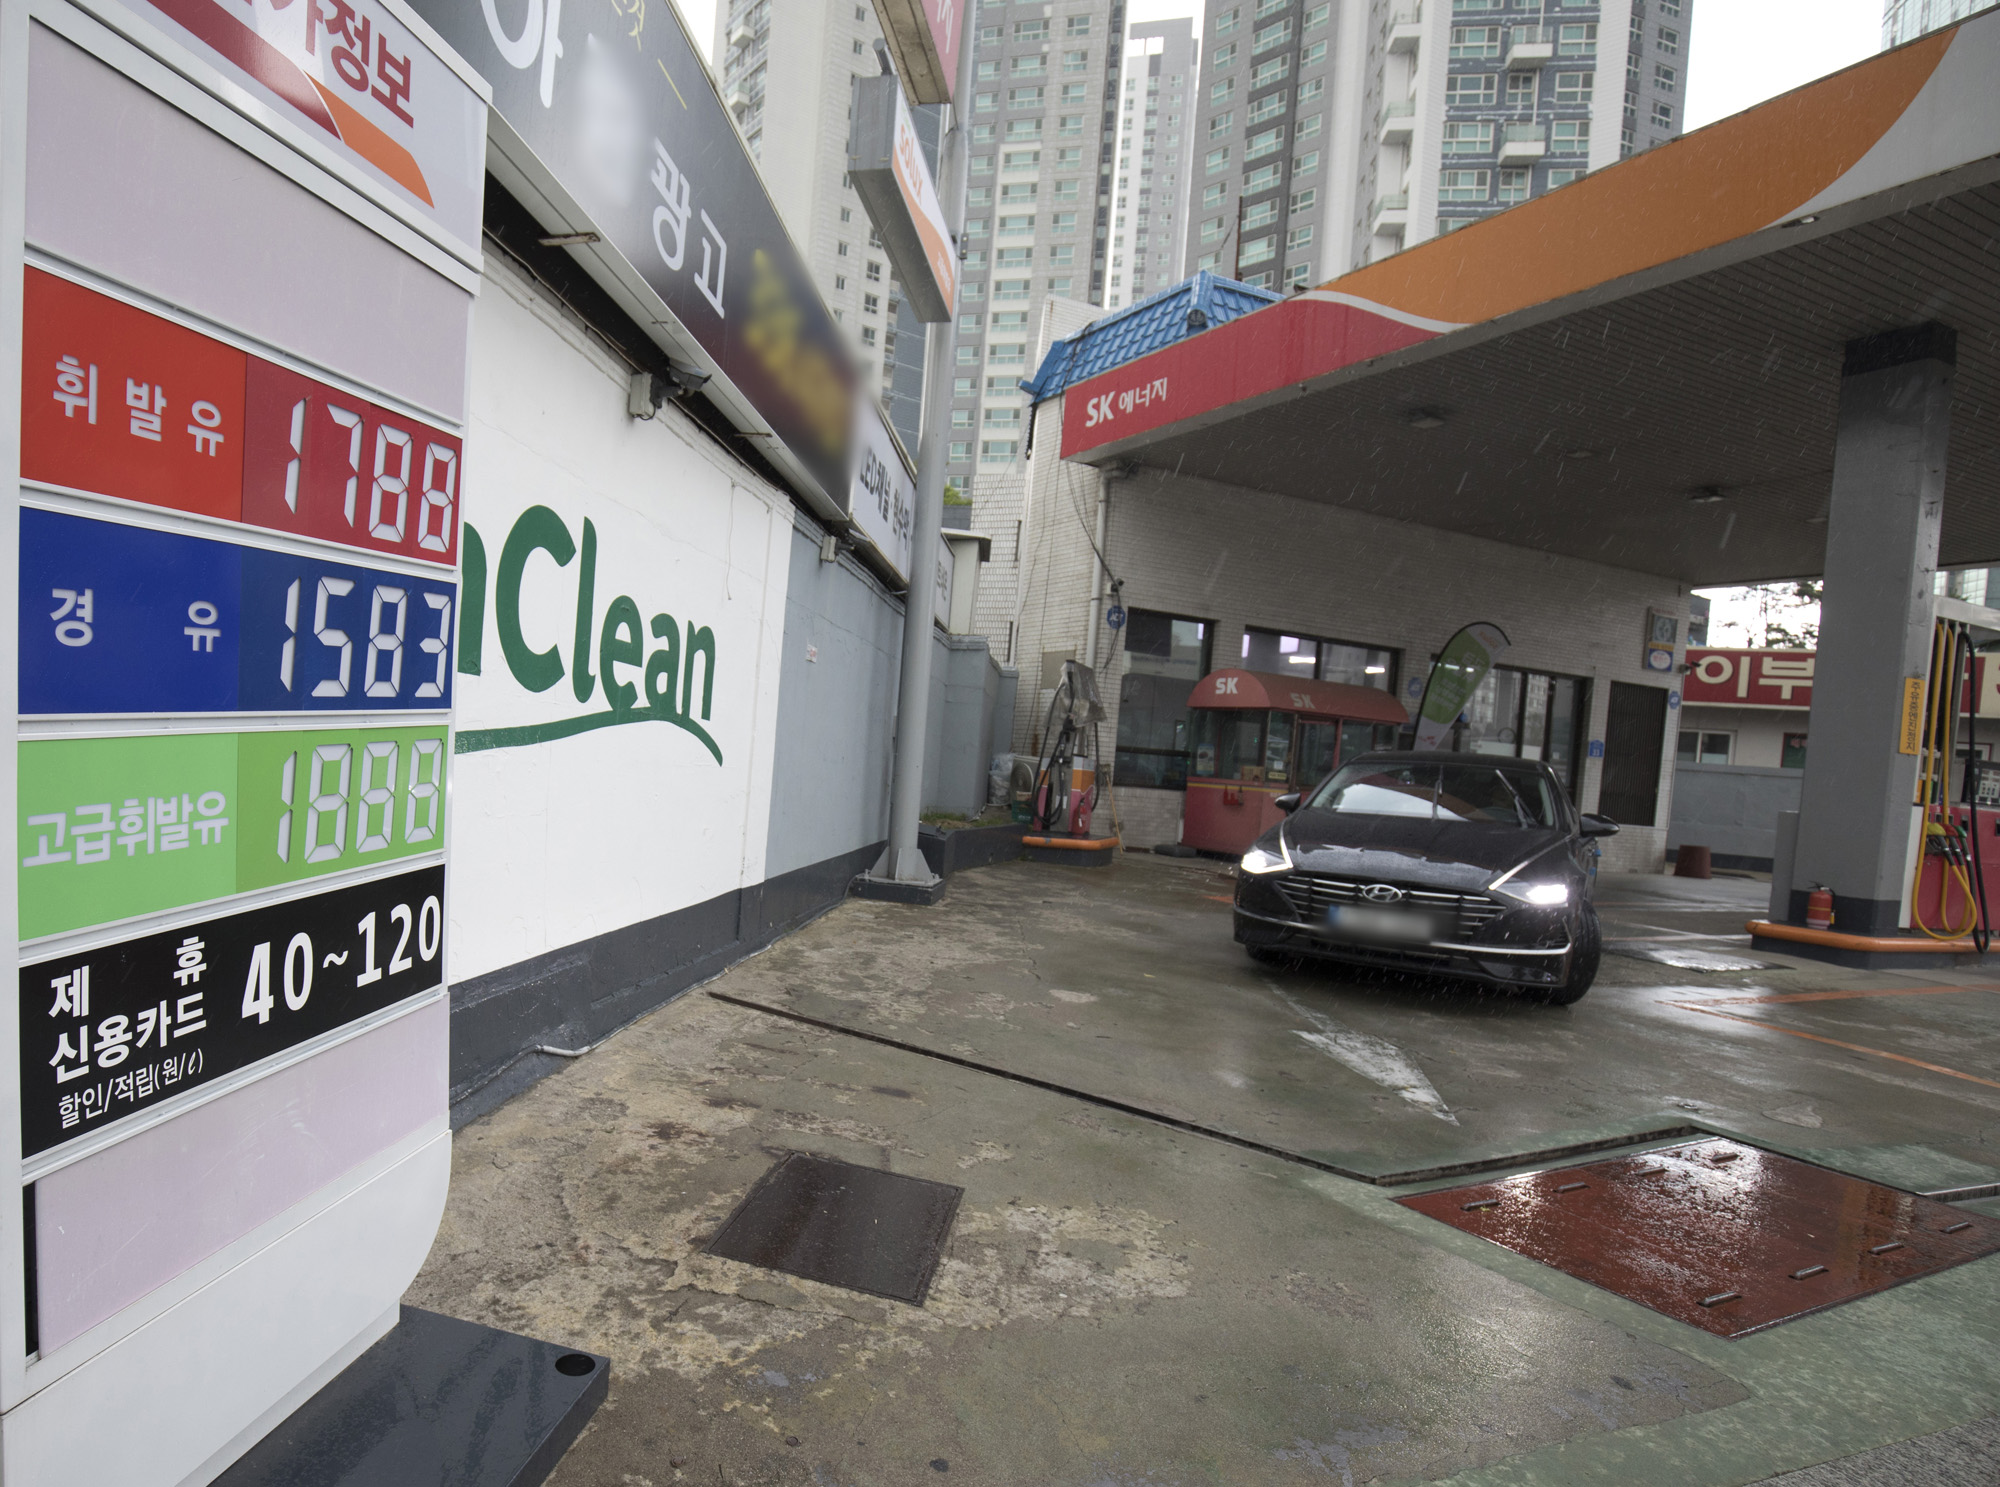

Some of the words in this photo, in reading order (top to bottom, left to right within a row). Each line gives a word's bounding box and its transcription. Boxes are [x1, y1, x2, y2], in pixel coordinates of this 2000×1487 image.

[53, 354, 224, 456] 휘발유
[284, 397, 457, 553] 1788
[1085, 391, 1116, 427] SK
[1118, 377, 1168, 414] 에너지
[280, 575, 452, 697] 1583
[1215, 677, 1238, 695] SK
[1290, 692, 1316, 709] SK
[22, 791, 229, 867] 고급휘발유
[277, 738, 444, 864] 1888
[241, 895, 441, 1025] 40~120
[49, 993, 207, 1084] 신용카드
